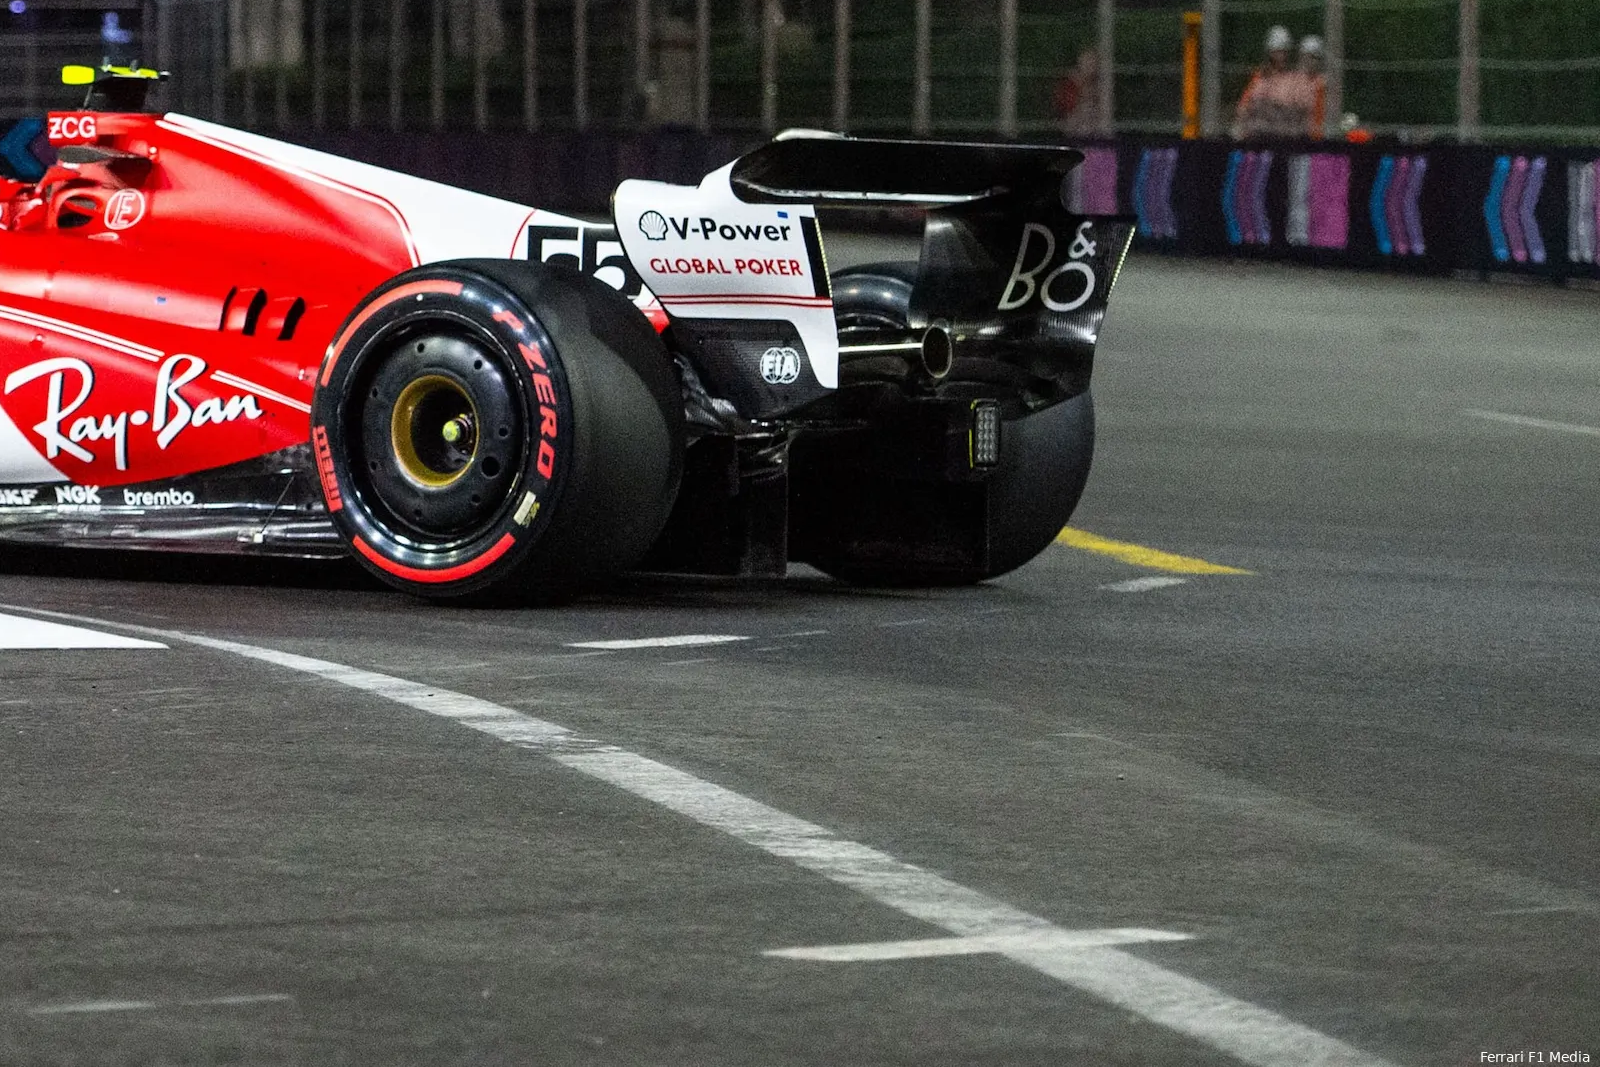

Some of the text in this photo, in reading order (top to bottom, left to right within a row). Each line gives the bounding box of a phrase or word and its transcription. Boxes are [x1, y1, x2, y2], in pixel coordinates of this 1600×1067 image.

[49, 116, 96, 139] ZCG
[669, 217, 791, 242] V-Power
[650, 257, 803, 277] GLOBAL POKER
[492, 309, 525, 335] P
[518, 341, 558, 480] ZERO
[55, 485, 101, 504] NGK
[123, 488, 195, 506] brembo
